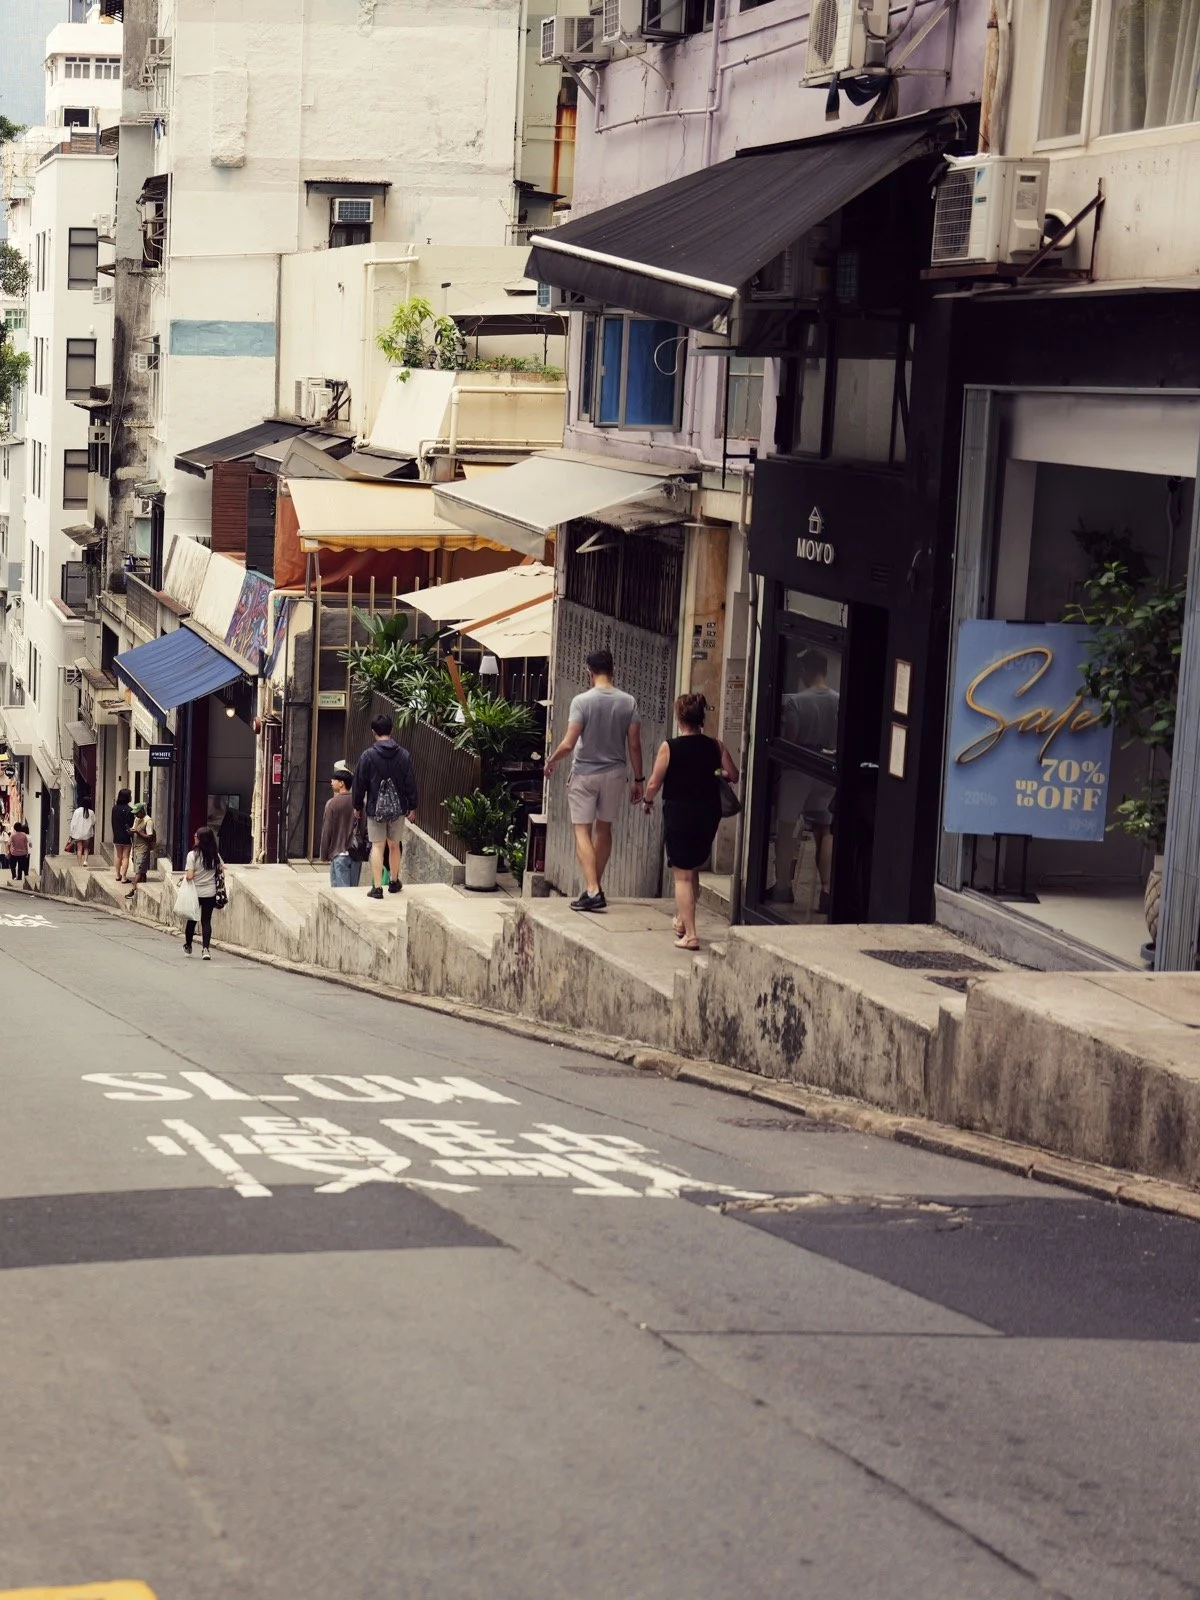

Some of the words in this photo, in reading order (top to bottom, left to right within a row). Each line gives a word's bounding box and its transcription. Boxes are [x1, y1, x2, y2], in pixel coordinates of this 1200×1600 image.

[796, 537, 835, 565] MOYO
[955, 645, 1103, 766] Sale
[1041, 758, 1106, 785] 70%
[1015, 779, 1038, 794] up
[1016, 793, 1034, 807] to
[1037, 785, 1103, 812] OFF
[81, 1071, 521, 1105] SLOW
